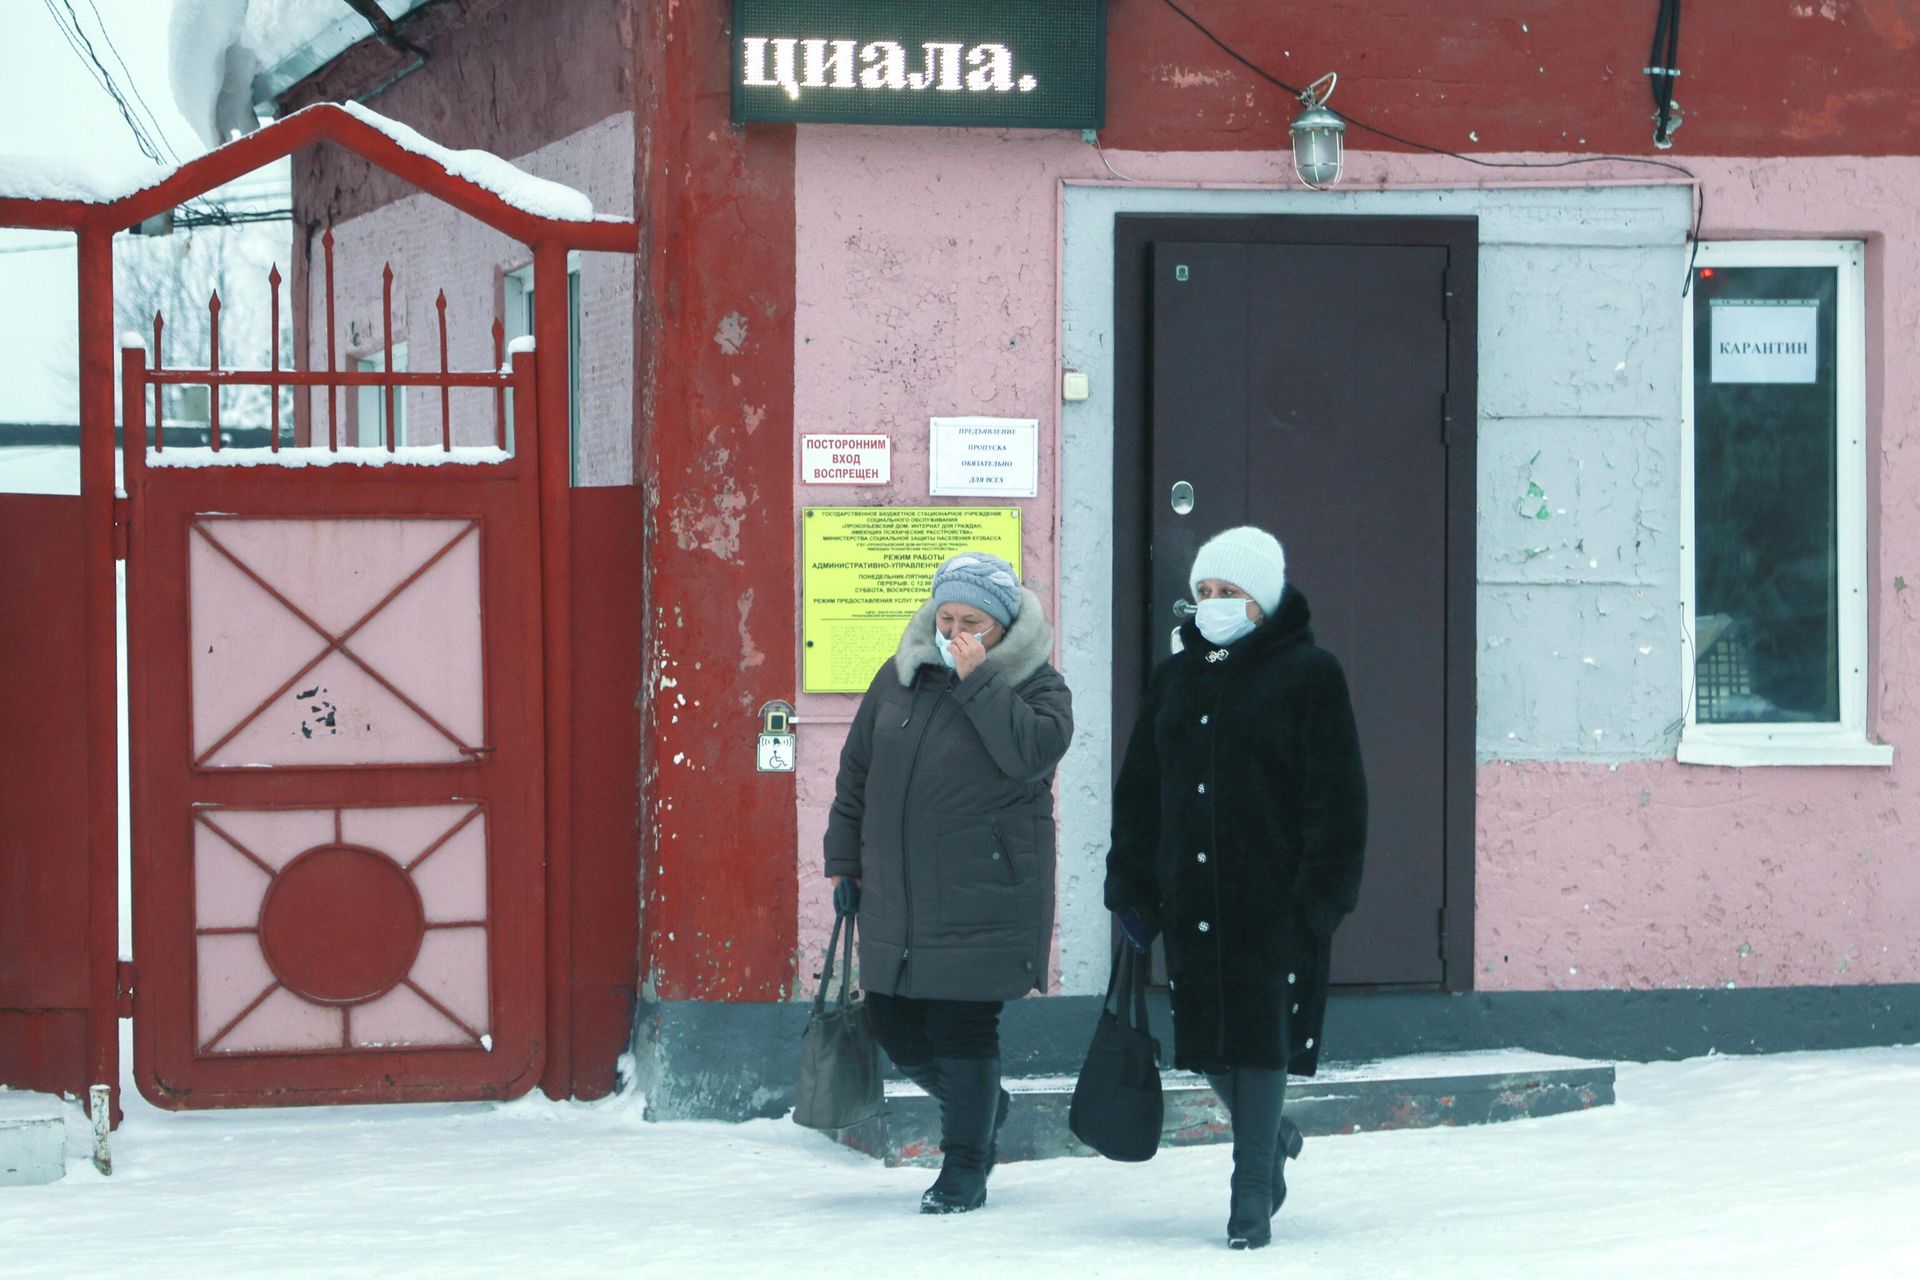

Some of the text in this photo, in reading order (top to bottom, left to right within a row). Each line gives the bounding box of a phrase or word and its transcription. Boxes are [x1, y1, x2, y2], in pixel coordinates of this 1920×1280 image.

[1719, 342, 1808, 354] КАРАНТИН
[806, 439, 886, 449] ПОСТОРОННИМ
[832, 454, 861, 465] ВХОД
[814, 468, 879, 480] ВОСПРЕЩЕН
